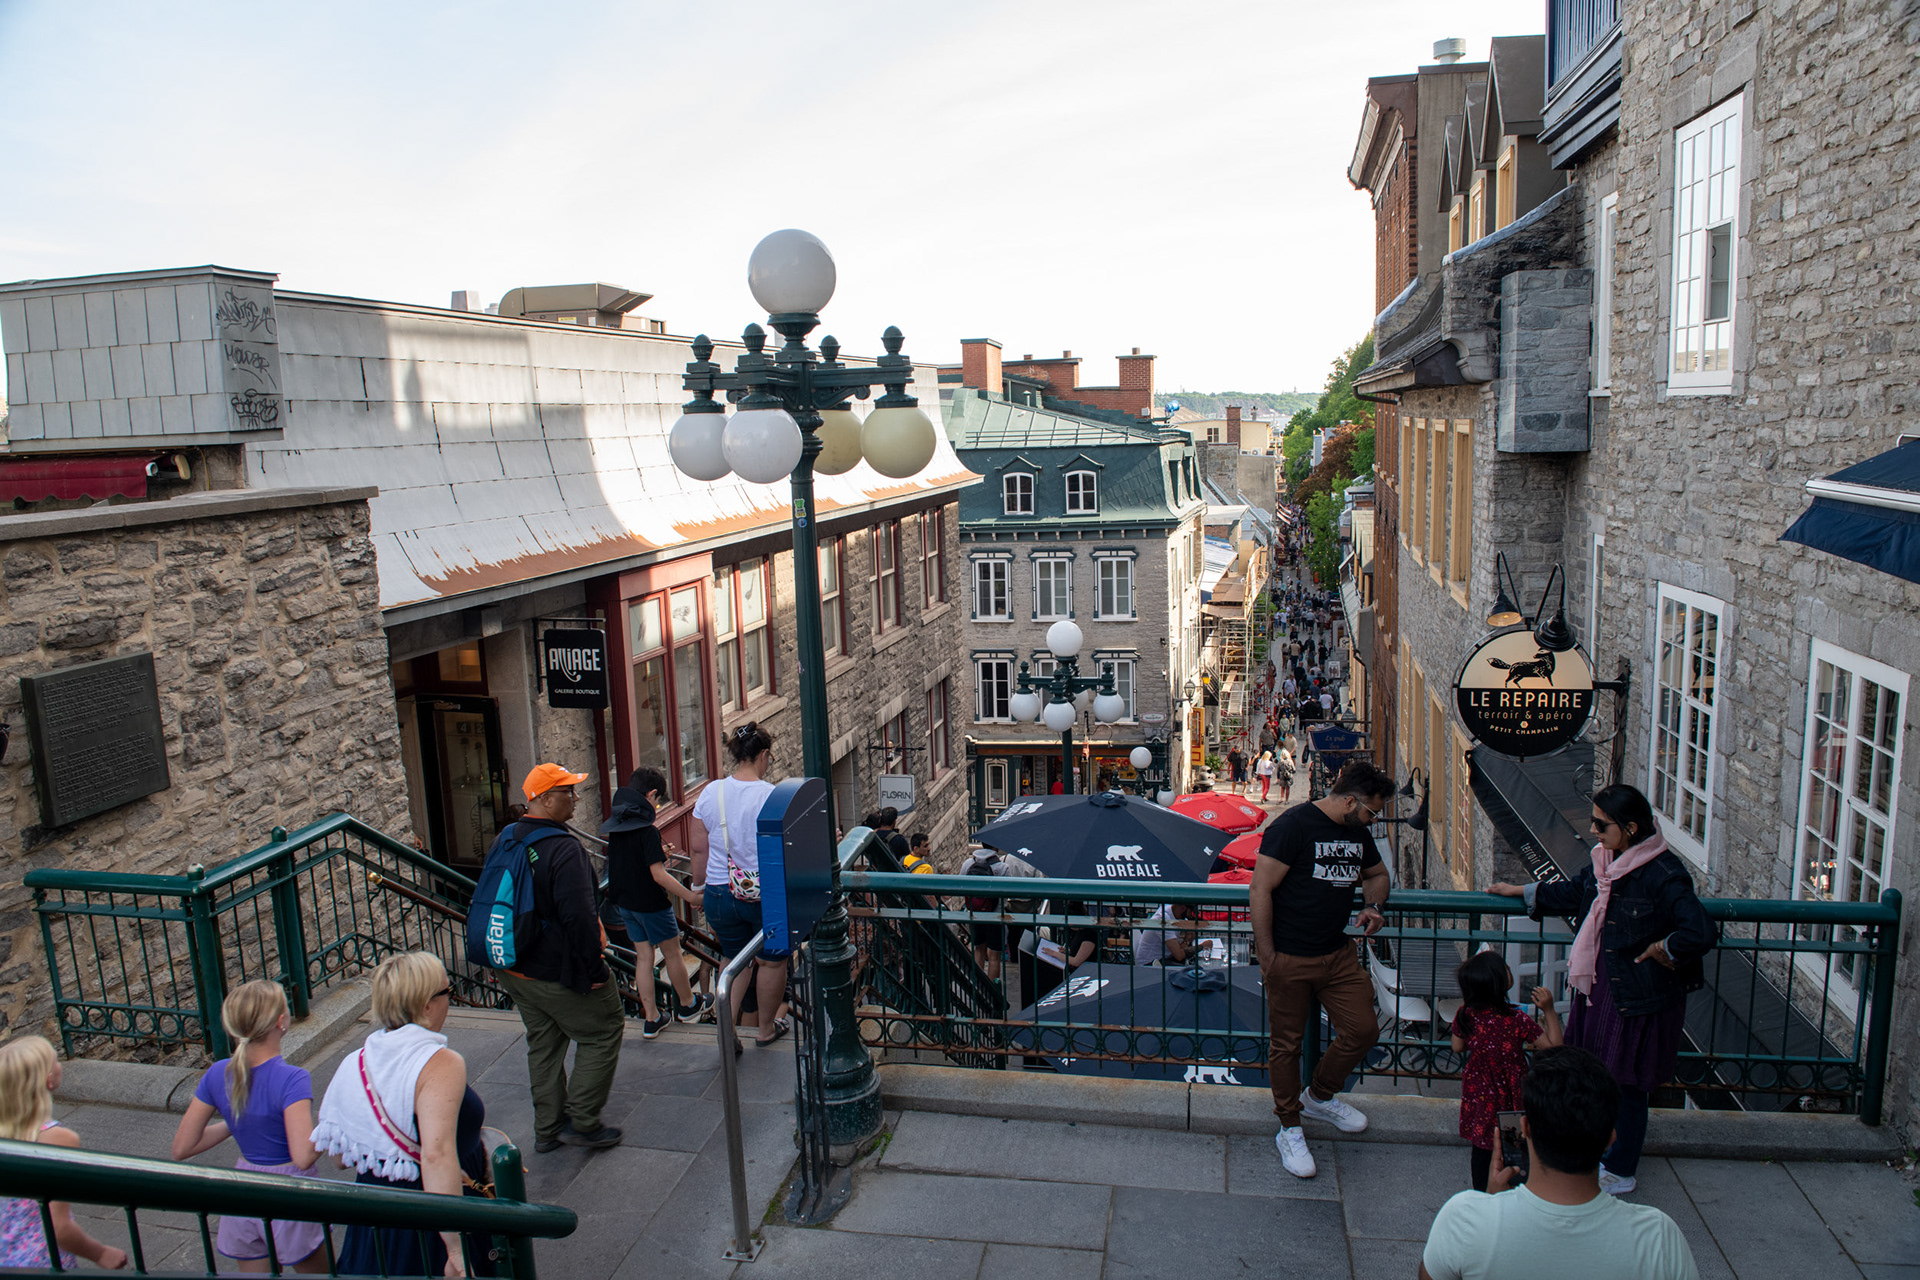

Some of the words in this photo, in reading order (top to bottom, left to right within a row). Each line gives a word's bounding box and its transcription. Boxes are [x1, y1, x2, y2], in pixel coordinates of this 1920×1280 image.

[1470, 691, 1490, 707] LE
[1500, 691, 1583, 708] REPAIRE
[1478, 710, 1519, 719] terroir
[1525, 710, 1532, 719] &
[1538, 711, 1572, 721] apéro
[1489, 724, 1512, 733] PETIT
[1516, 725, 1559, 734] CHAMPLAIN
[881, 791, 911, 799] FLORIN
[1318, 844, 1353, 858] JACK
[1520, 842, 1542, 865] terroir
[1533, 861, 1555, 880] LE
[1095, 862, 1162, 878] BORÉALE
[486, 913, 506, 967] safari
